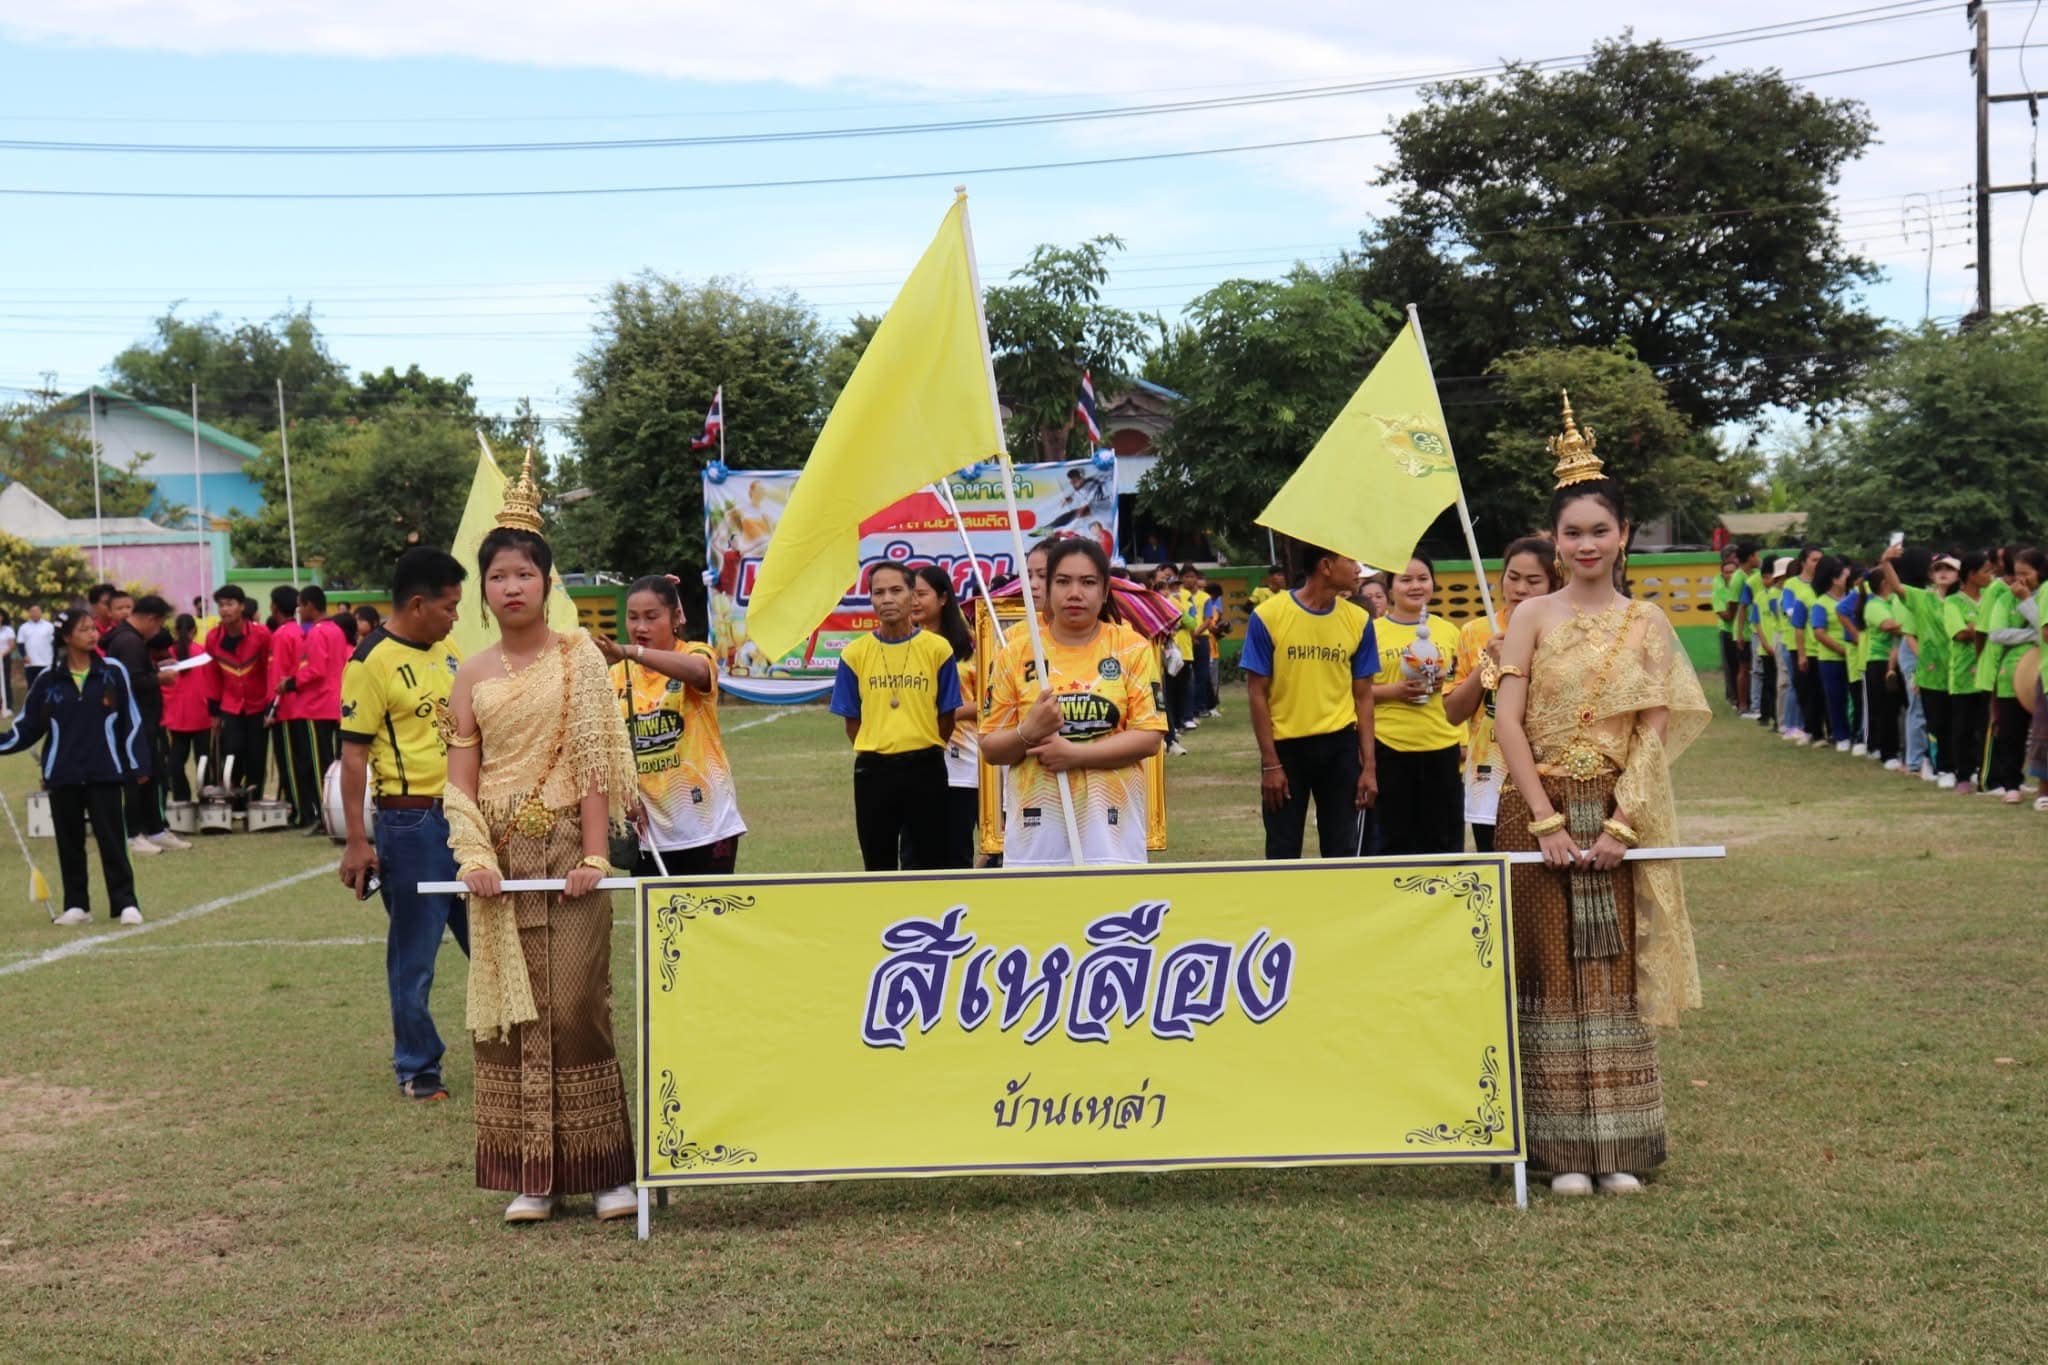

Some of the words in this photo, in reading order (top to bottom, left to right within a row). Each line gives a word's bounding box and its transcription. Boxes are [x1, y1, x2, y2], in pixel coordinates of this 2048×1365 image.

[397, 663, 418, 690] 11
[1060, 701, 1110, 721] NWAY
[633, 714, 678, 738] NWAY
[862, 899, 1297, 1049] สีเหลือง
[993, 1071, 1167, 1133] บ้านเหล่า
